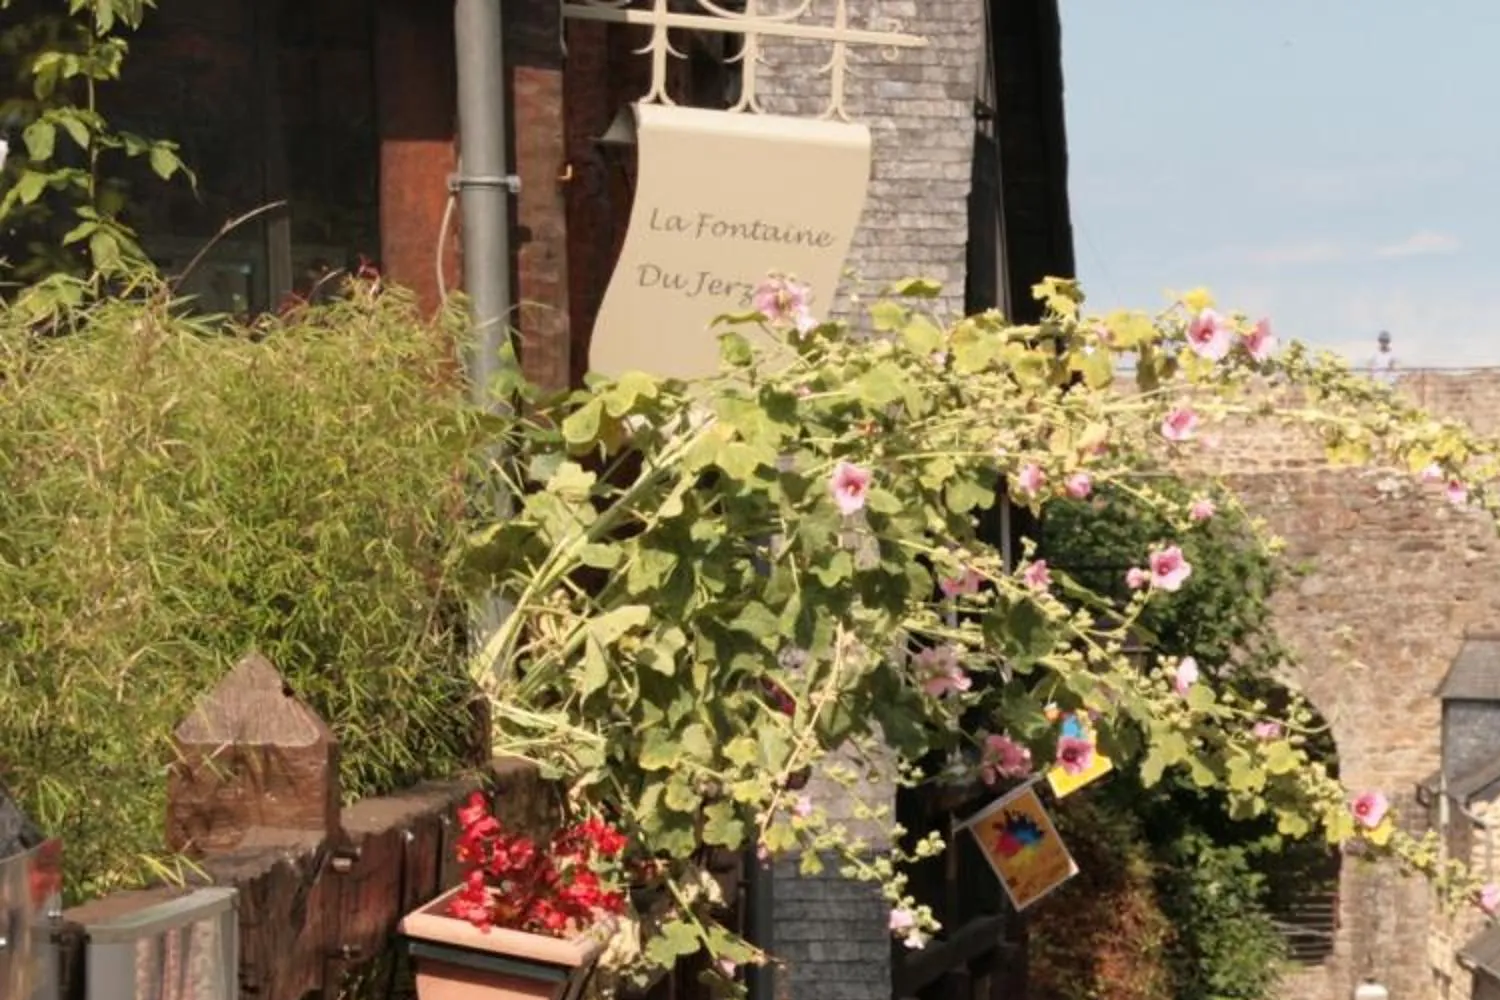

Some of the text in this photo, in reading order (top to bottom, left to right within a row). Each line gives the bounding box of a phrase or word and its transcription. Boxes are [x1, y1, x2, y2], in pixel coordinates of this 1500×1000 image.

[649, 206, 836, 248] La Fontaine
[637, 263, 780, 306] Du Jerz
